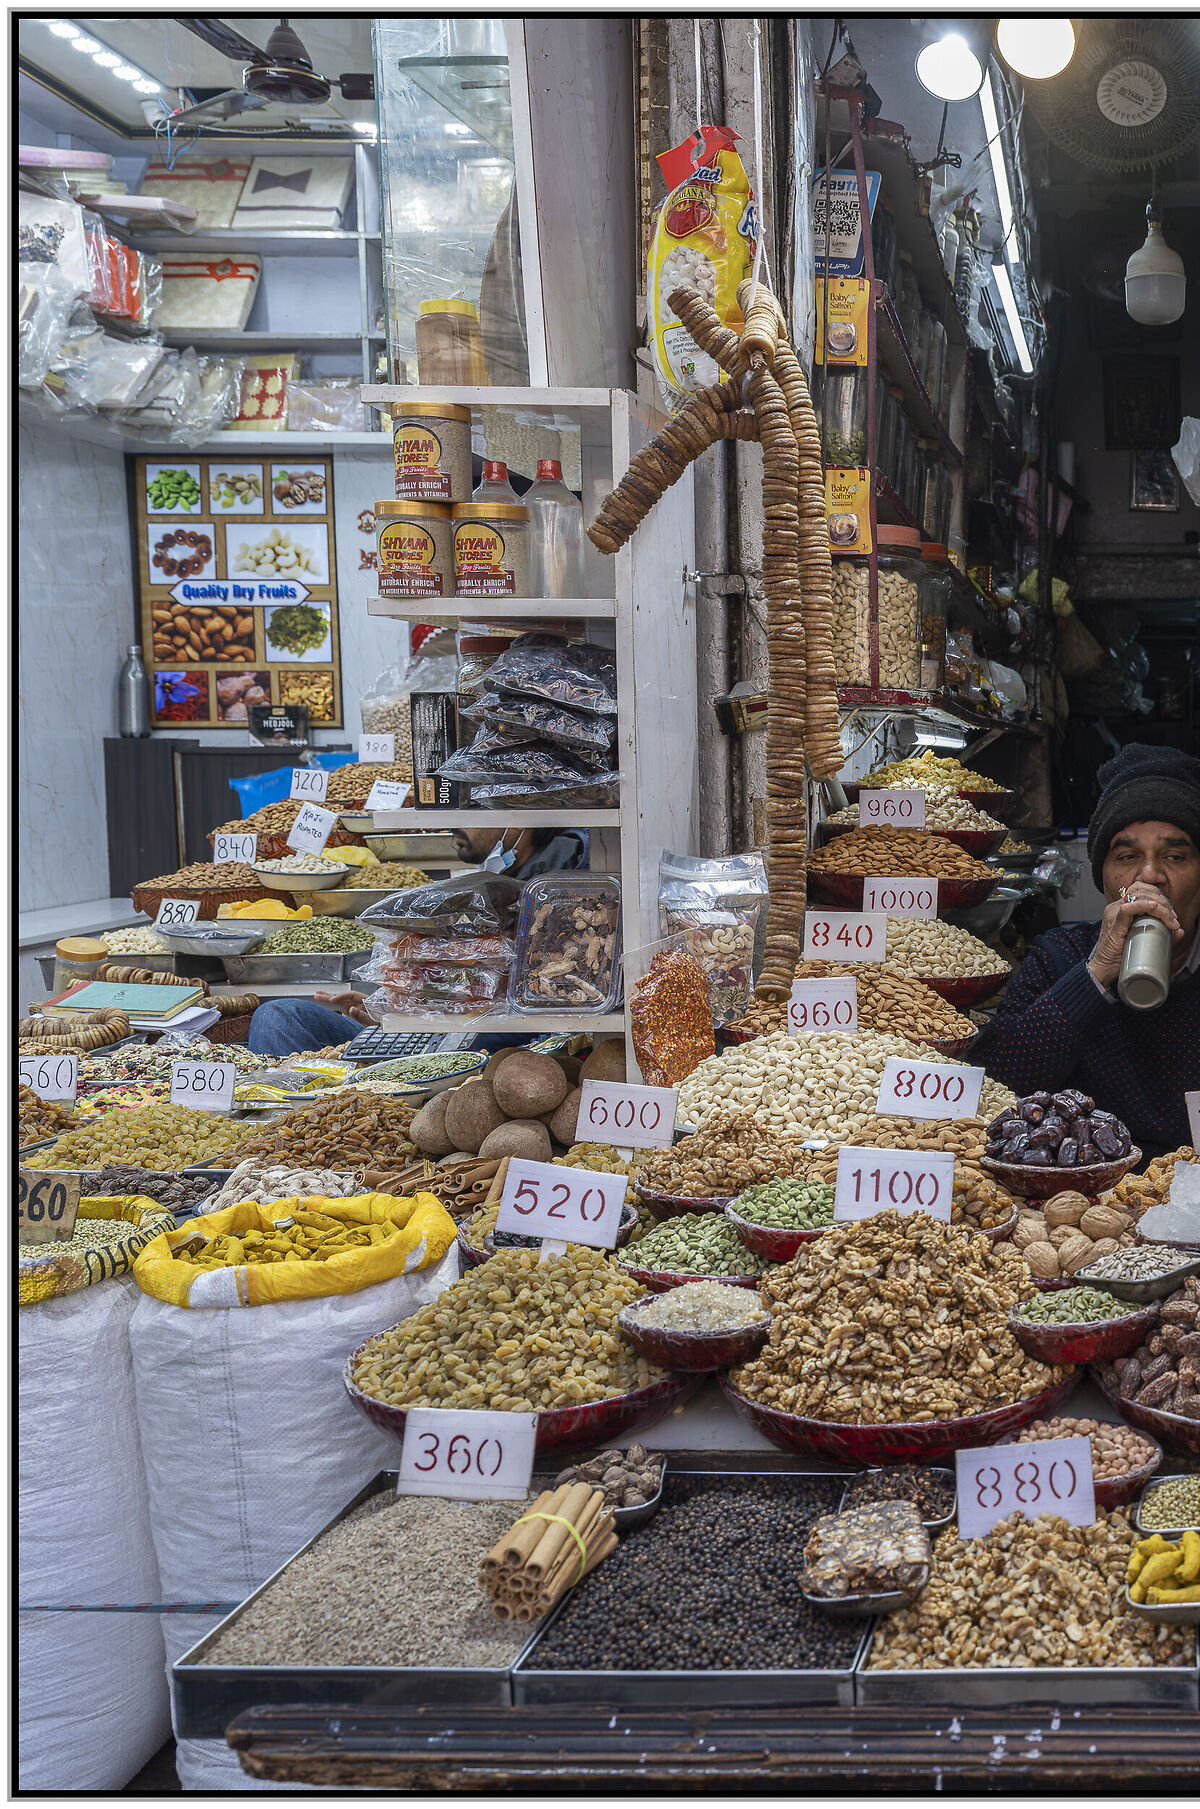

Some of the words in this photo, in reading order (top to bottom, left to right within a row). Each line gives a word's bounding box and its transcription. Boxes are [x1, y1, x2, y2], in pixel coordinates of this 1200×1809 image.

[830, 293, 849, 304] Baby
[830, 302, 852, 310] Saffron
[395, 440, 433, 453] SHYAM
[397, 453, 429, 464] STORES
[418, 481, 442, 489] ENRICH
[831, 483, 849, 493] Baby
[383, 536, 428, 550] SHYAM
[456, 536, 497, 550] SHYAM
[386, 551, 423, 561] STORES
[459, 551, 493, 561] STORES
[411, 578, 435, 588] ENRICH
[483, 578, 506, 587] ENRICH
[182, 584, 229, 602] Quality
[232, 584, 255, 602] Dry
[258, 584, 297, 599] Fruits
[263, 719, 295, 728] MEDJOOL
[293, 771, 323, 792] 920
[439, 778, 451, 804] 500gr
[302, 809, 324, 823] KAJU
[867, 798, 913, 818] 960
[296, 822, 322, 838] ROASTED
[217, 835, 254, 860] 840
[869, 889, 933, 911] 1000
[160, 902, 196, 924] 880
[812, 921, 873, 948] 840
[790, 1000, 853, 1028] 960
[19, 1059, 74, 1089] 560
[176, 1067, 226, 1093] 580
[894, 1069, 965, 1102] 800
[588, 1097, 661, 1130] 600
[852, 1168, 939, 1206] 1100
[513, 1179, 606, 1222] 520
[414, 1432, 503, 1476] 360
[976, 1460, 1077, 1508] 880
